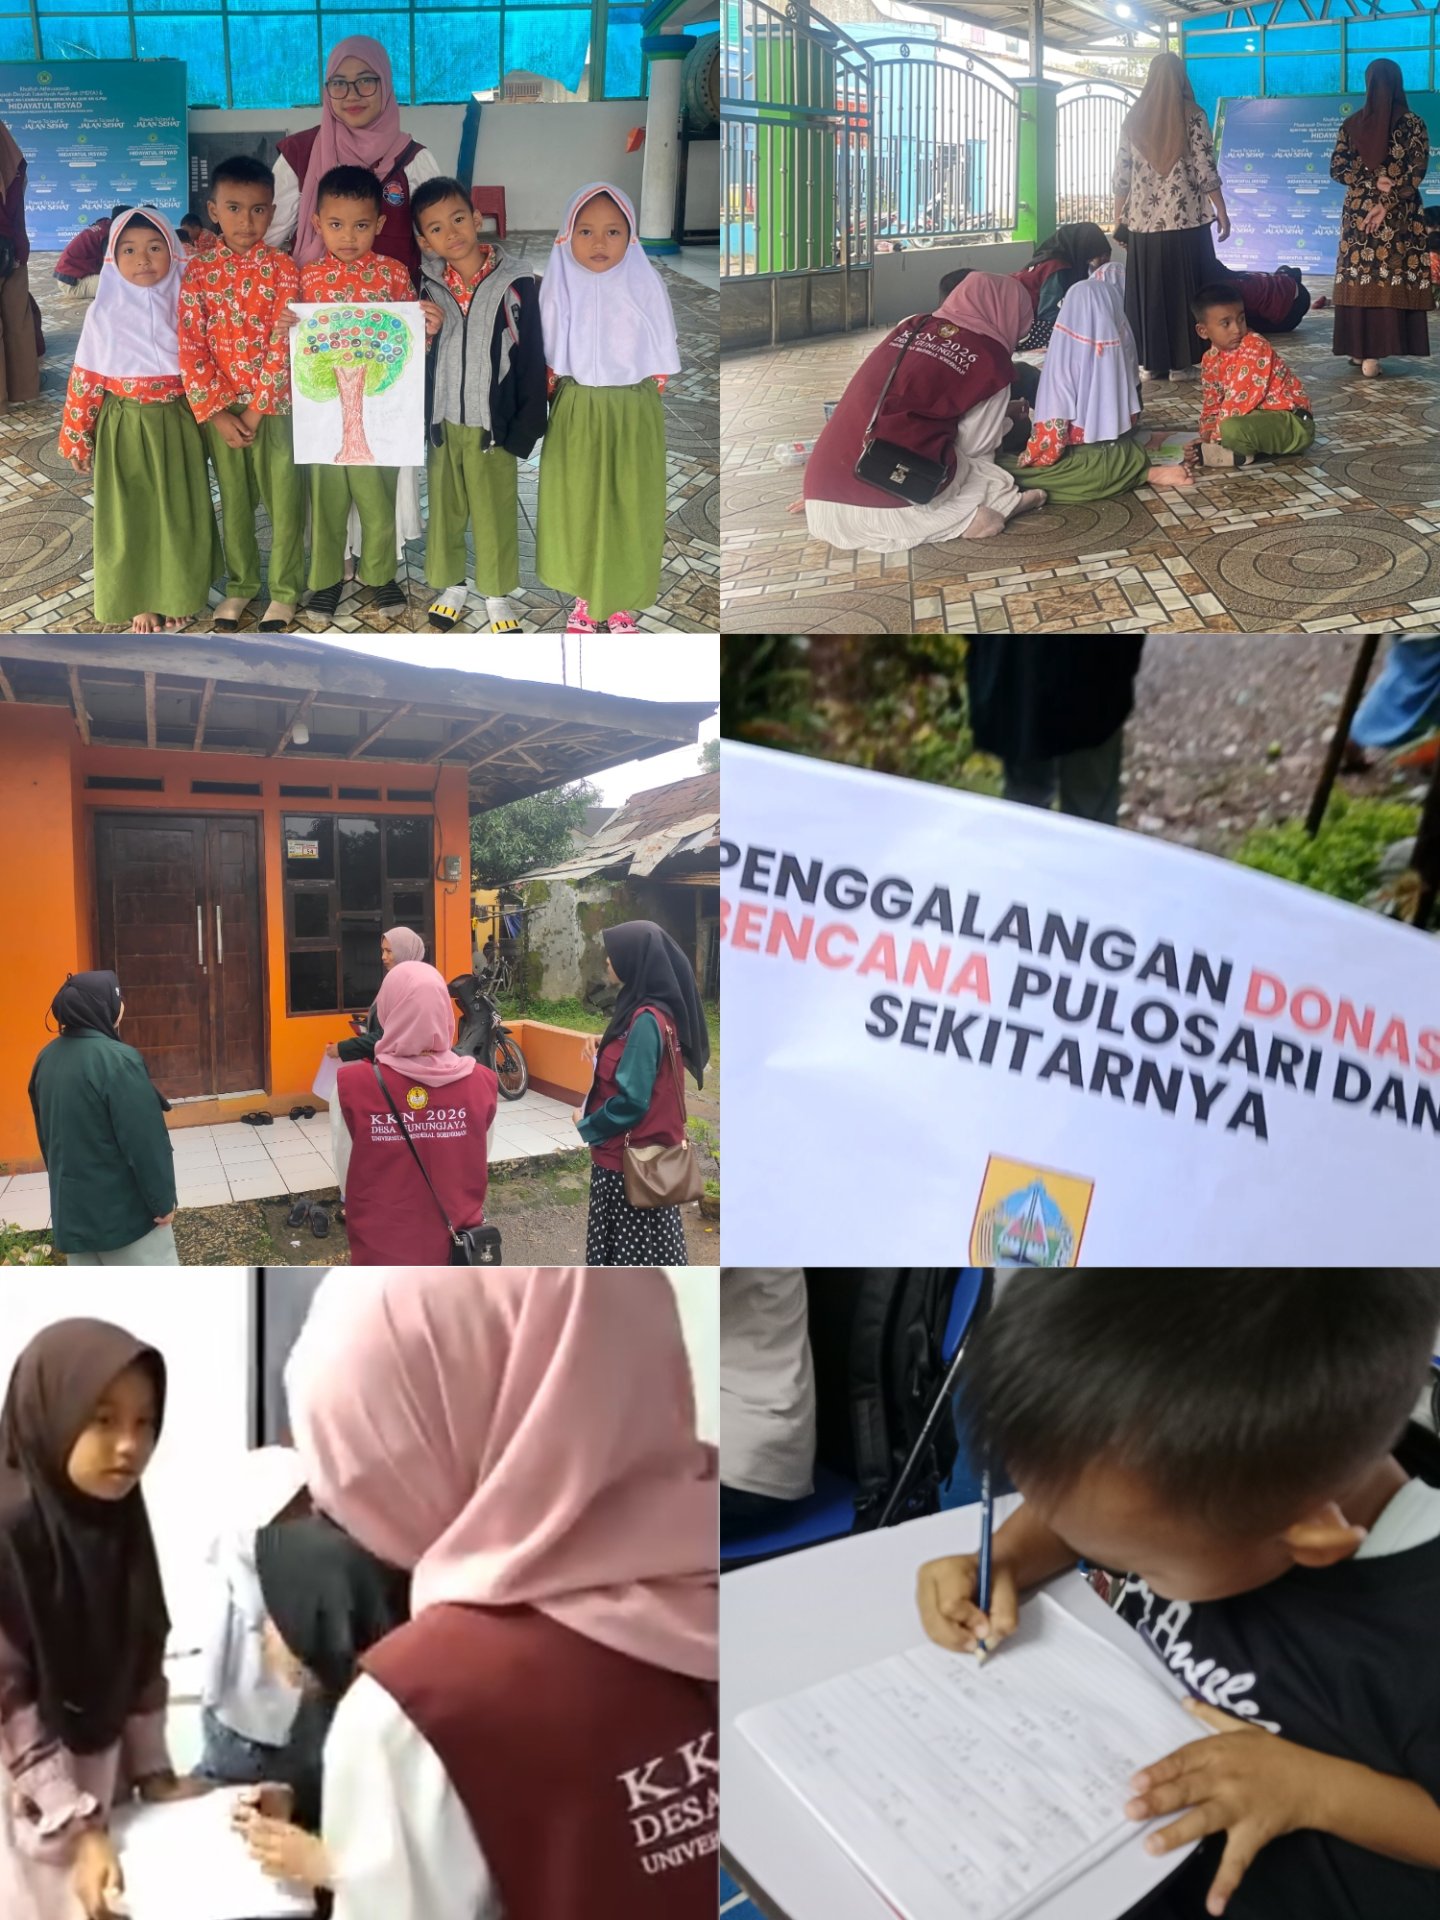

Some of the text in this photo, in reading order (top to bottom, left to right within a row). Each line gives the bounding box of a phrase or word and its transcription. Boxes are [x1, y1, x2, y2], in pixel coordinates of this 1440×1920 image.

[914, 340, 970, 370] GUNUNGJAYA
[940, 339, 978, 363] 2026
[720, 839, 1233, 1002] PENGGALANGAN
[1008, 962, 1323, 1096] PULOSARI
[1332, 1056, 1440, 1136] DAN
[864, 989, 1268, 1144] SEKITARNYA
[370, 1107, 467, 1125] KKN 2026
[371, 1120, 467, 1134] DESA UNUNGJAYA
